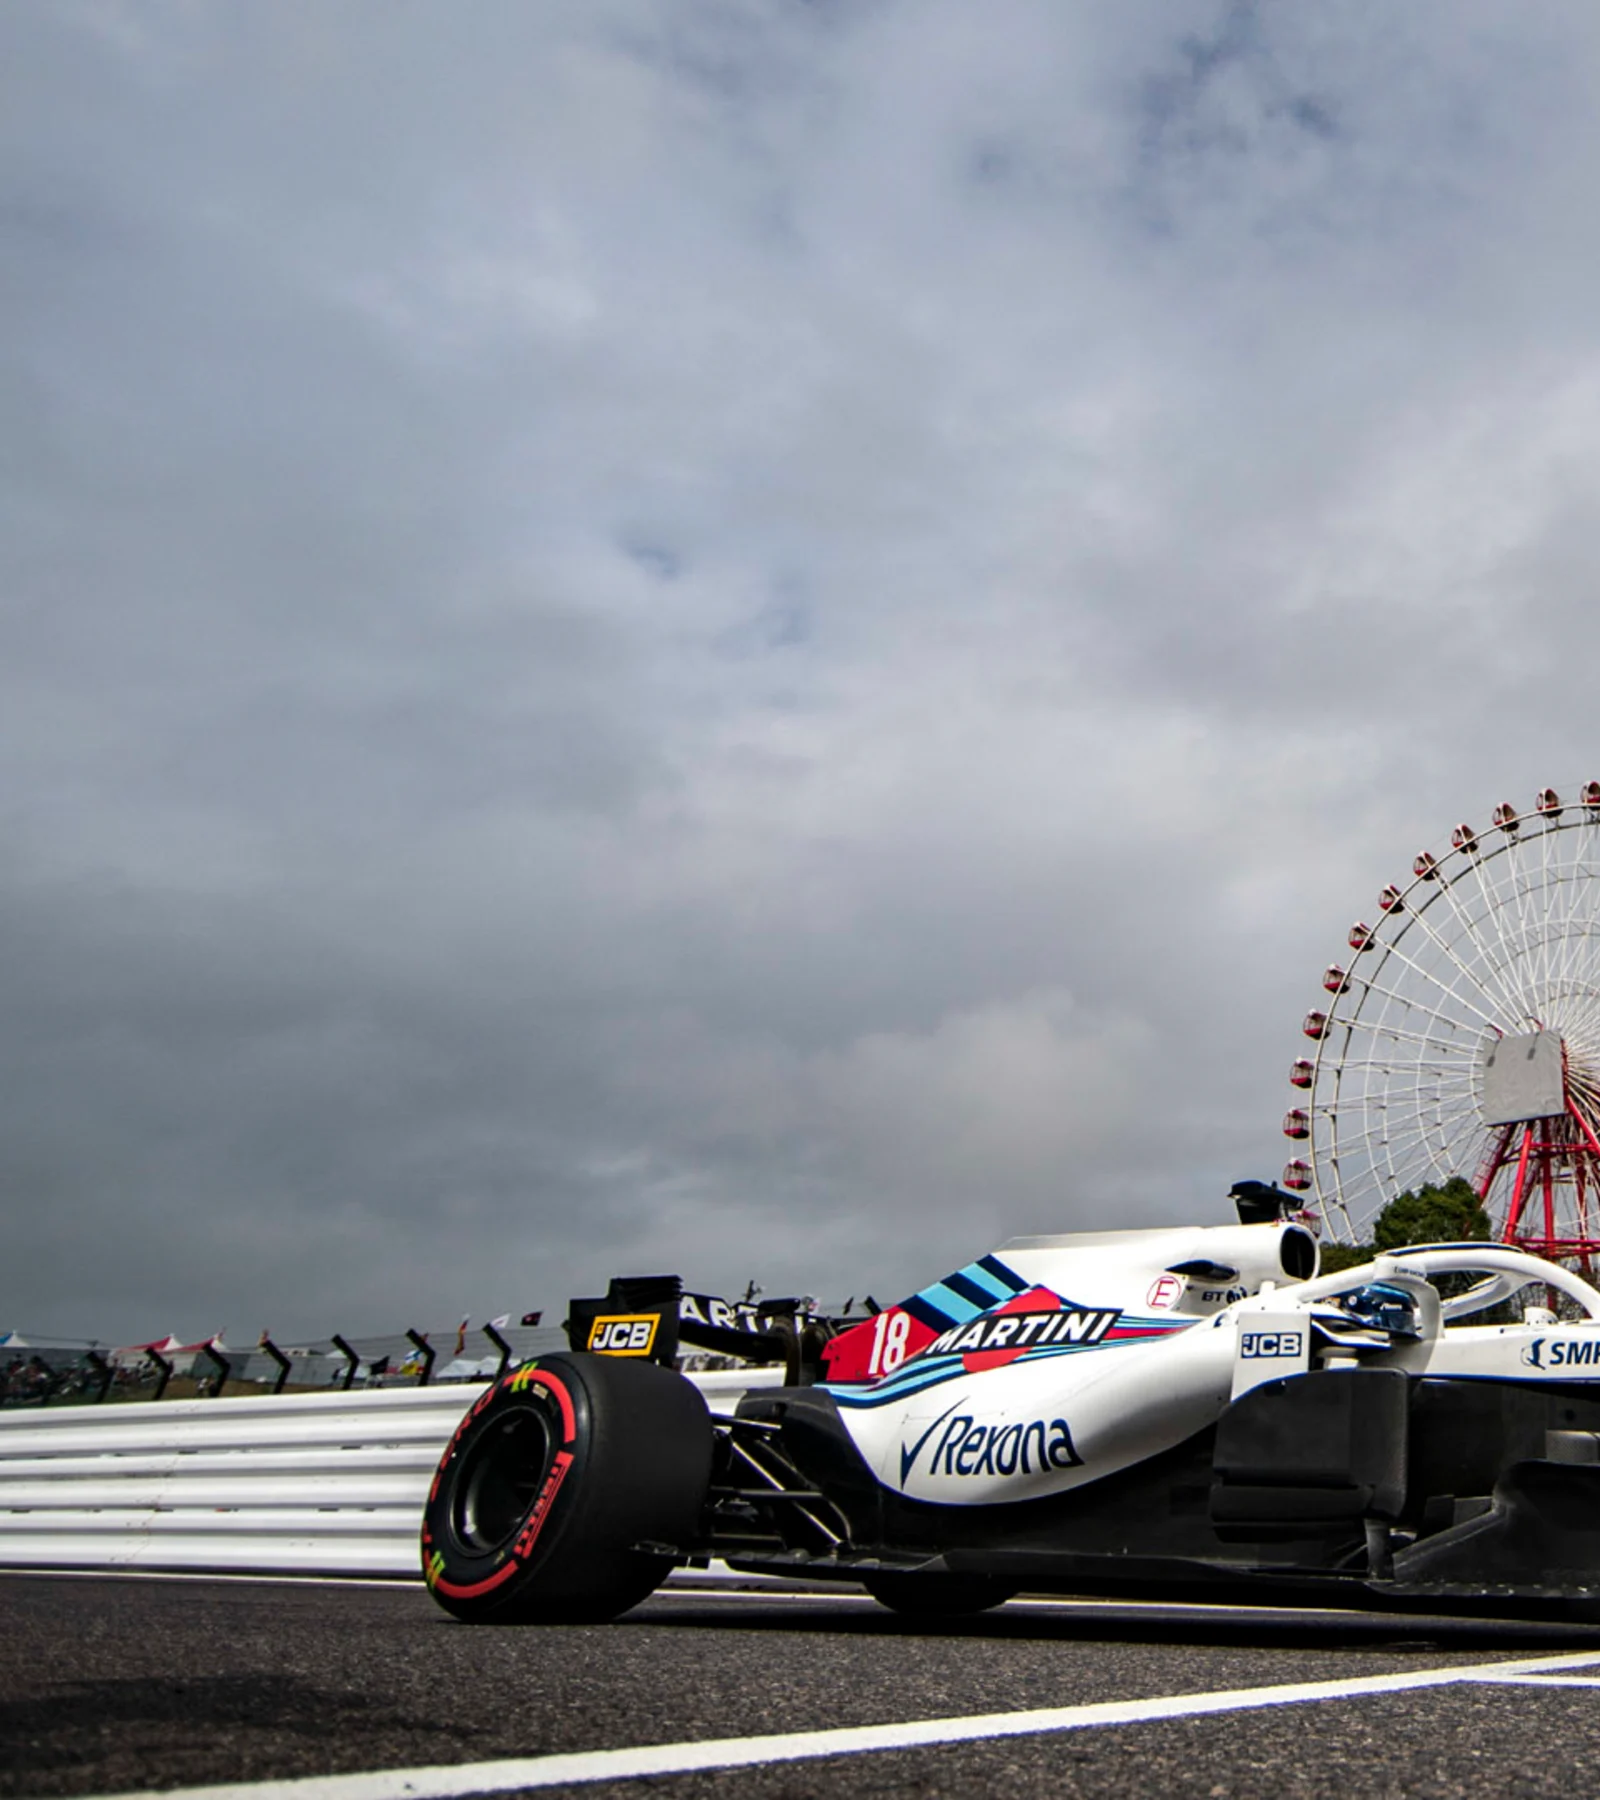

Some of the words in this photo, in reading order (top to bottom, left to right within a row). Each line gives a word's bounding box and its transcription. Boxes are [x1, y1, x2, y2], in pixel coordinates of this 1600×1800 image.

[1151, 1280, 1175, 1308] E
[1202, 1291, 1225, 1302] BT
[591, 1321, 653, 1350] JCB
[868, 1312, 911, 1374] 18
[926, 1312, 1121, 1355] MARTINI
[1242, 1333, 1301, 1358] JCB
[929, 1415, 1086, 1476] Rexona
